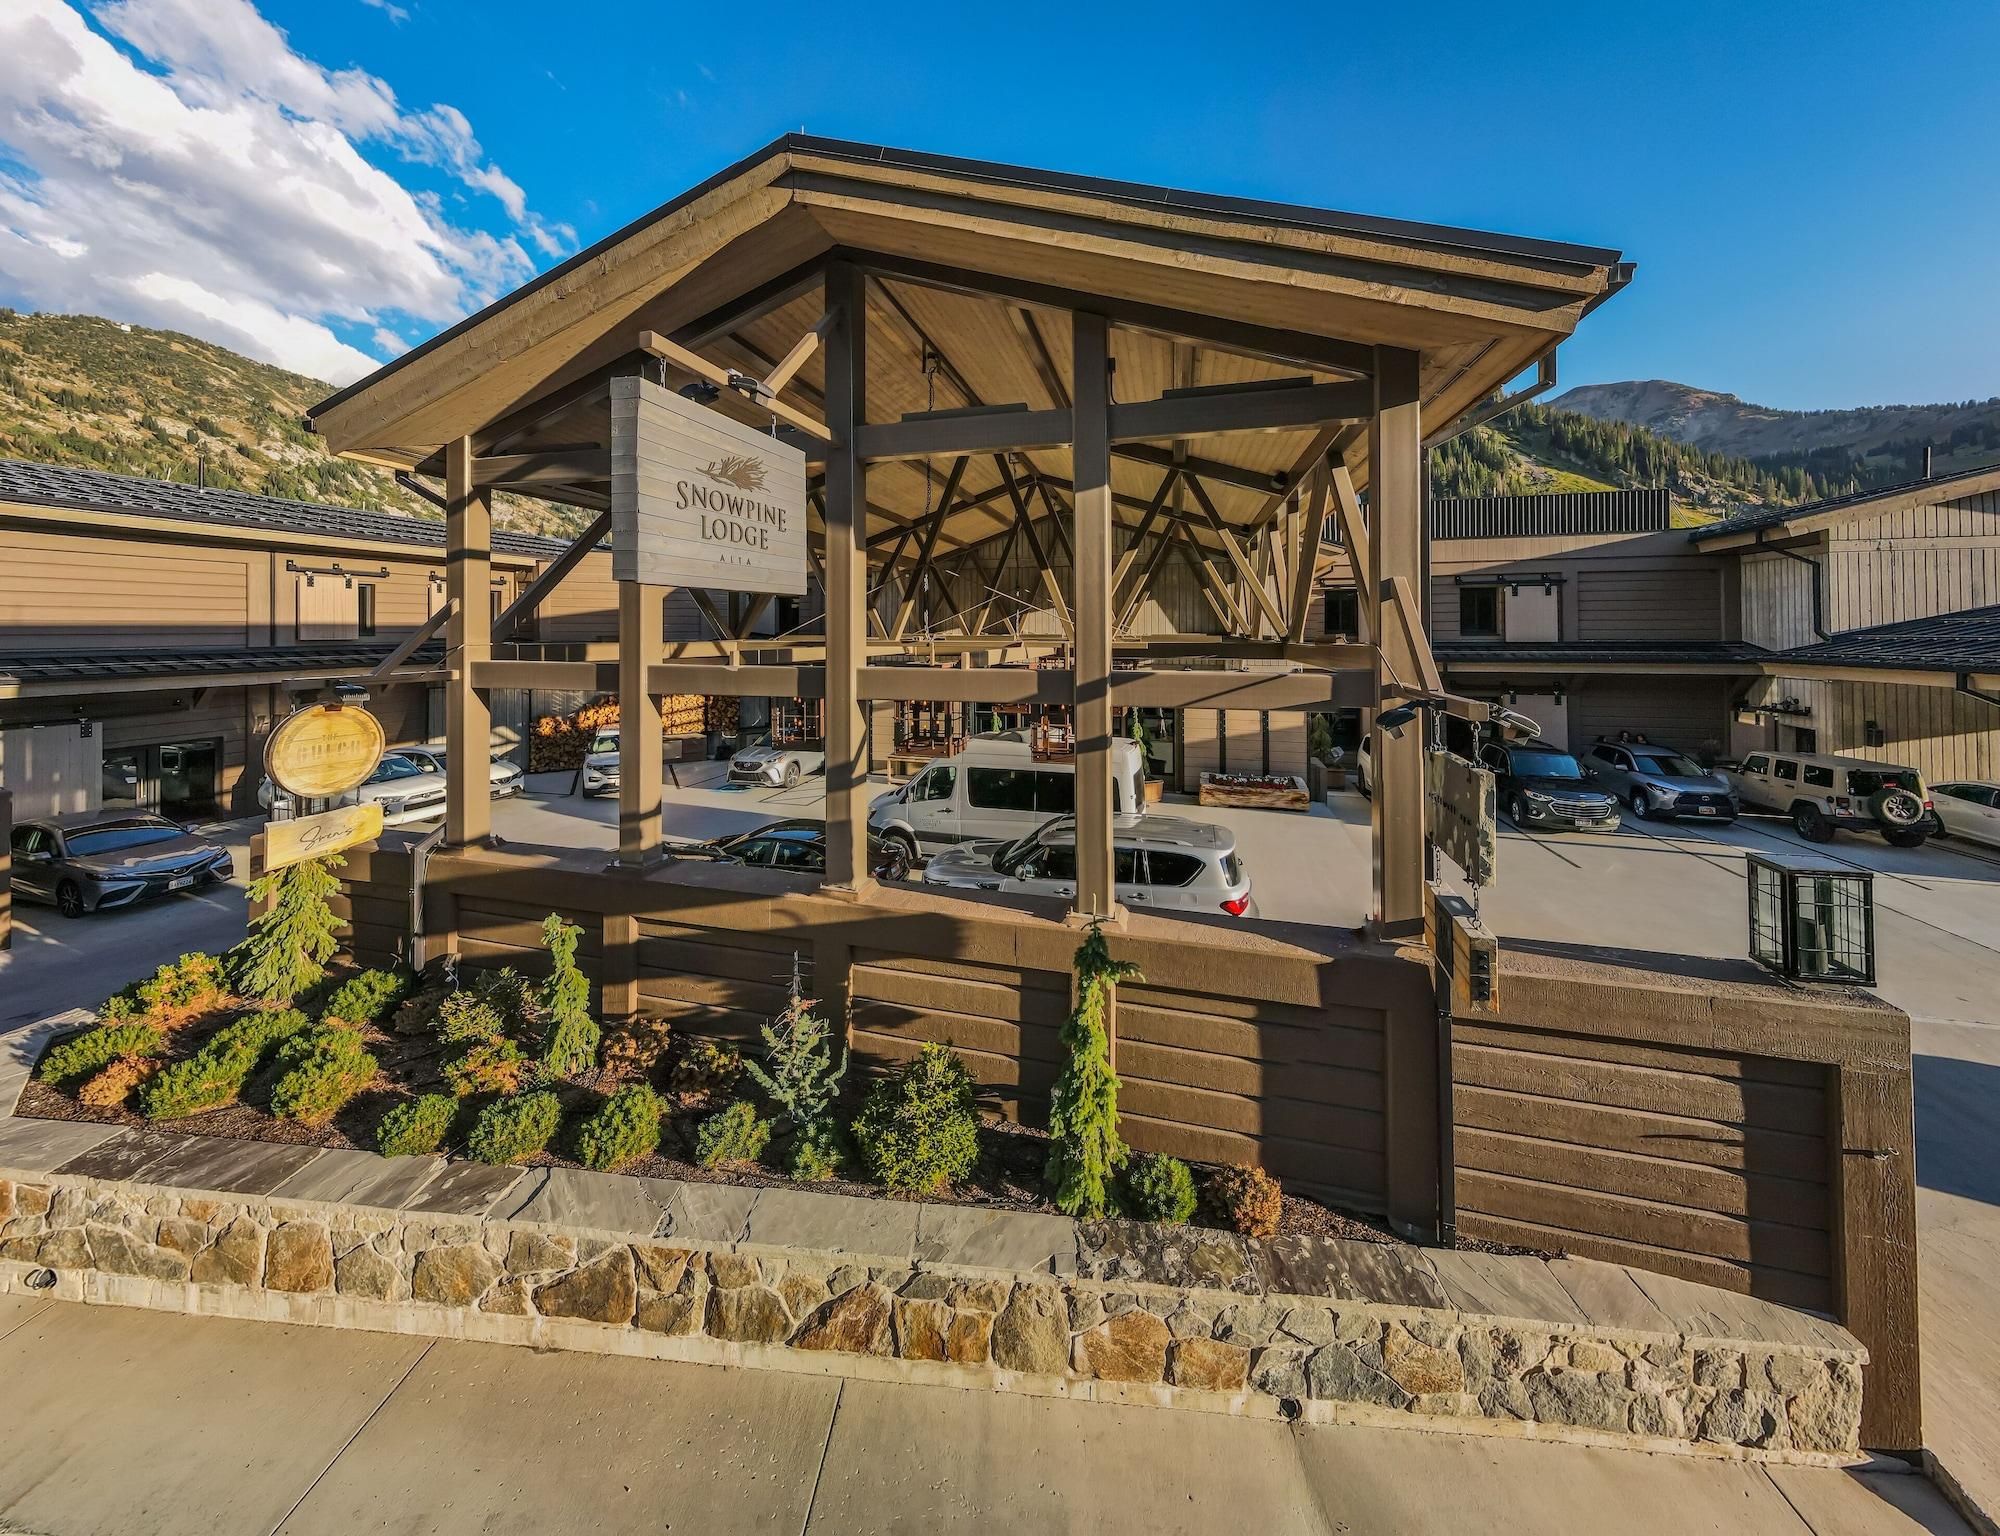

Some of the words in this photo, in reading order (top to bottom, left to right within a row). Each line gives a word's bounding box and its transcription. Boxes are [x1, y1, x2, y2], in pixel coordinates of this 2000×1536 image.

[676, 480, 787, 533] SNOWPINE
[700, 514, 769, 550] LODGE
[719, 554, 752, 566] ALTA
[322, 733, 337, 742] THE
